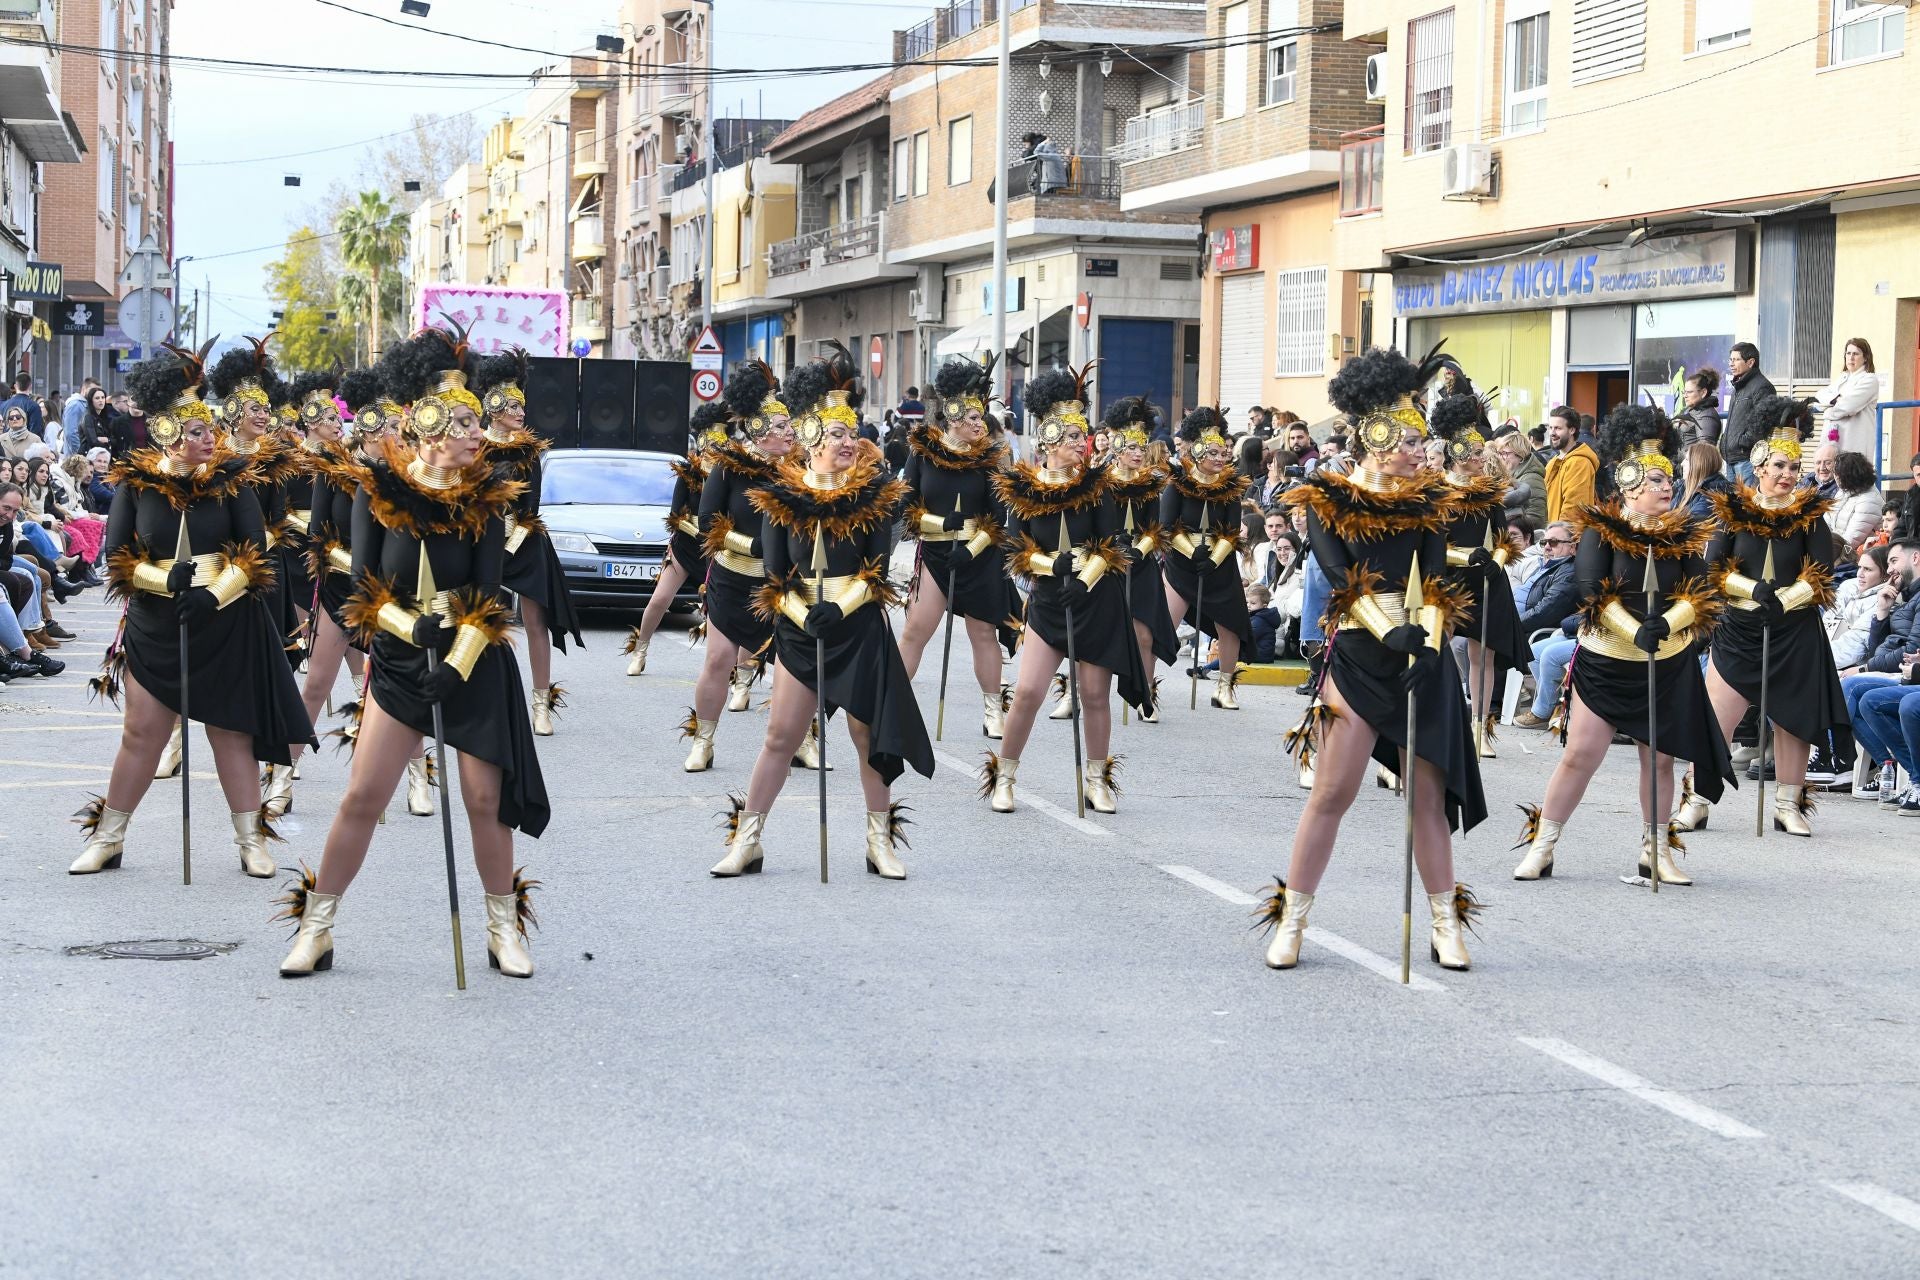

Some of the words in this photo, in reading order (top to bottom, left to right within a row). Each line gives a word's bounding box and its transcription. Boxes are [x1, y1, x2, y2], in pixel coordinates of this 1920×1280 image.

[42, 268, 61, 295] 100
[1395, 283, 1435, 314] GRUPO
[1511, 254, 1598, 301] NICOLAS
[1599, 269, 1658, 292] PROMOCIONES
[1659, 263, 1726, 287] INMOBILIARIAS
[699, 380, 716, 391] 30
[613, 565, 643, 577] 8471
